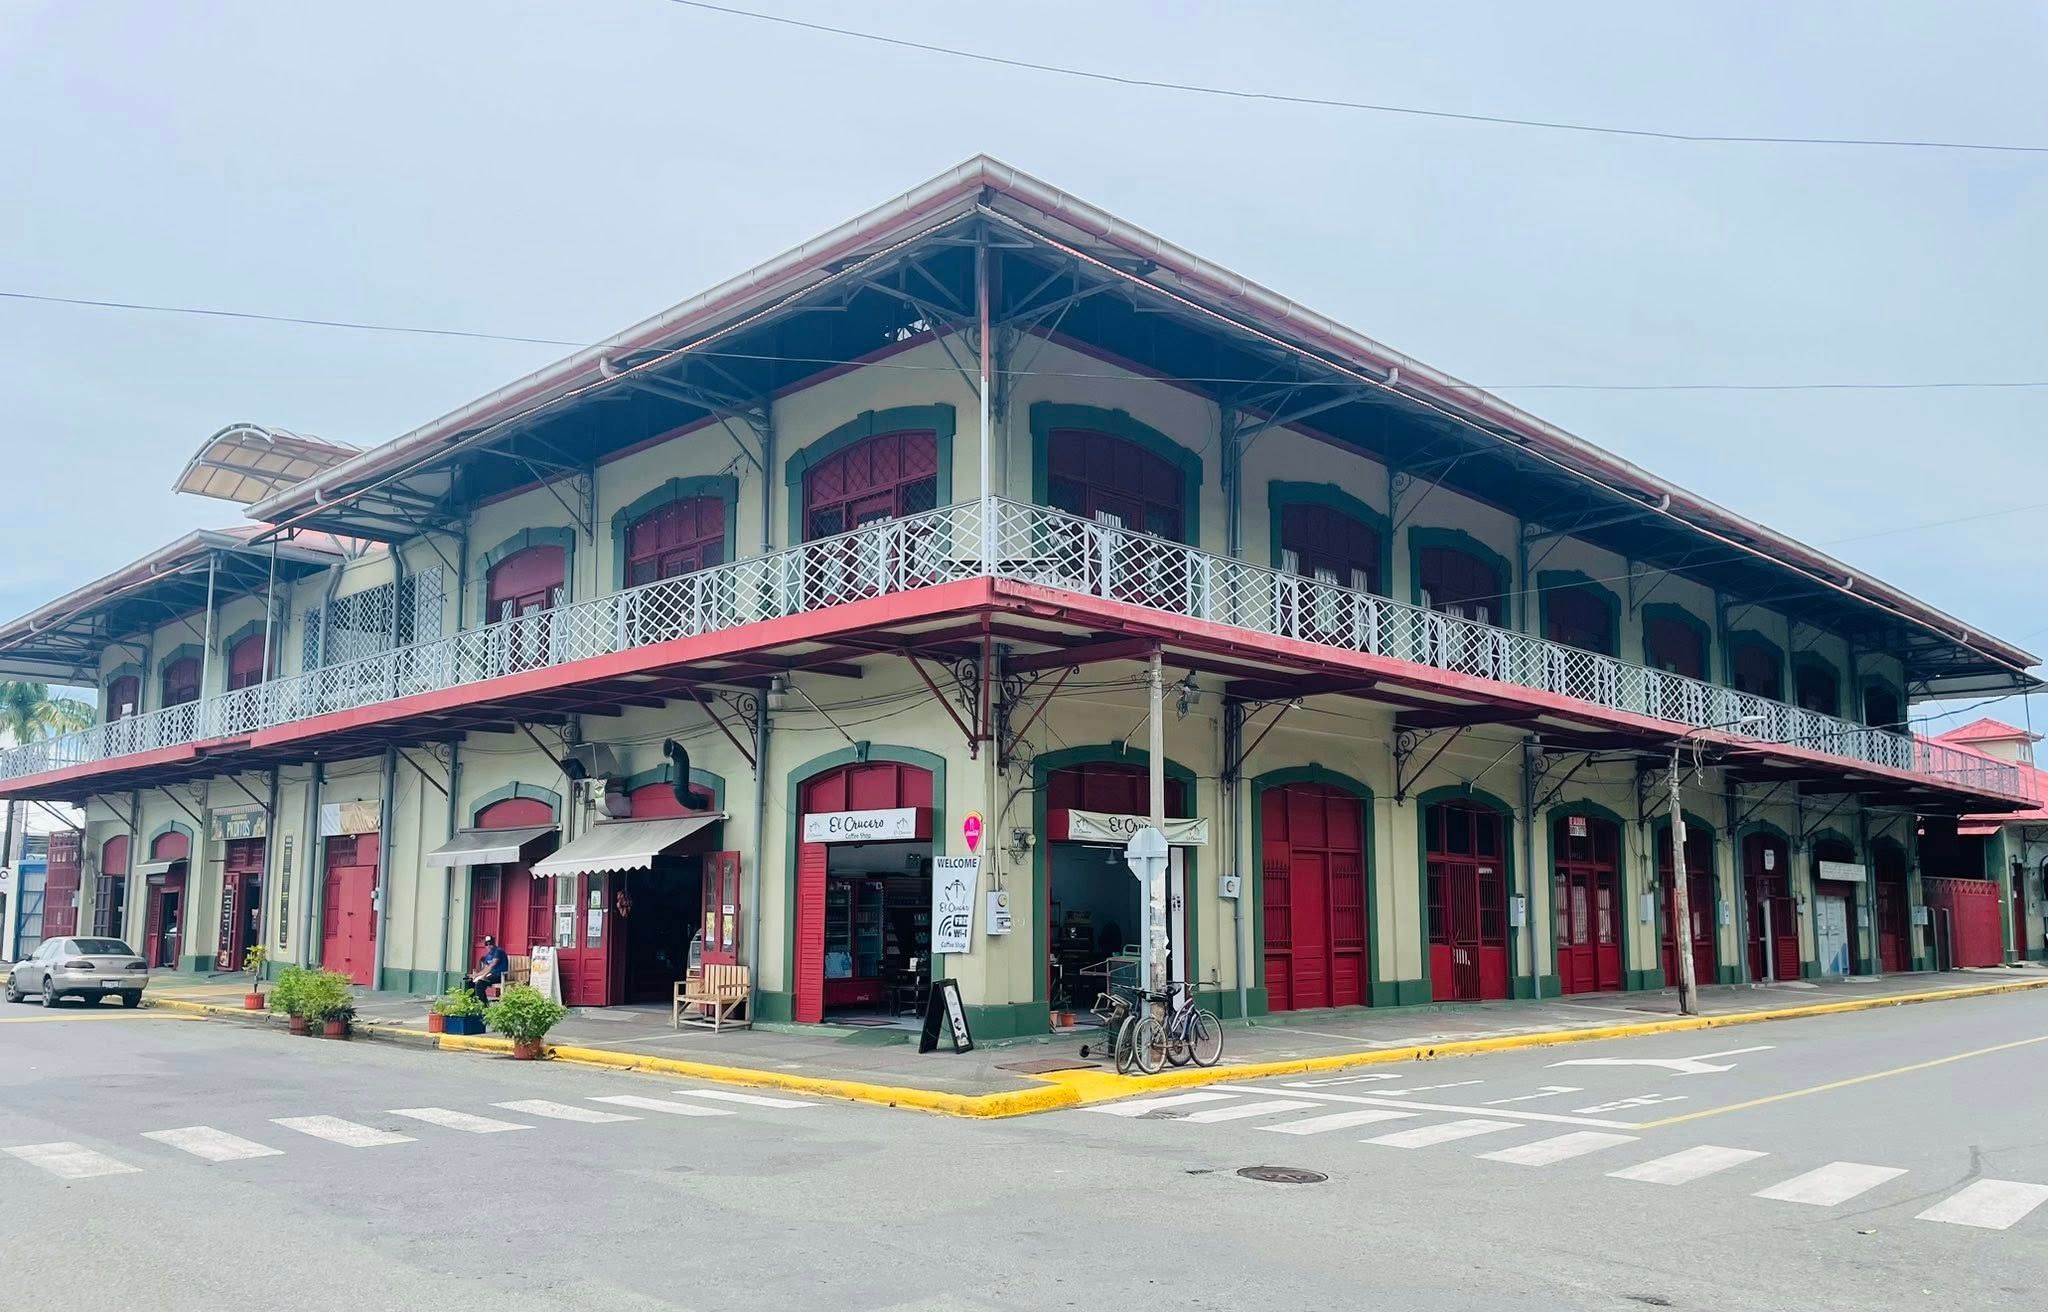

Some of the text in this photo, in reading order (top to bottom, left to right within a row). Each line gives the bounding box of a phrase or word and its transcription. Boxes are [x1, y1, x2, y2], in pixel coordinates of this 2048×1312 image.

[829, 816, 884, 833] El Crucero
[1108, 816, 1123, 833] El
[860, 832, 872, 840] Shop
[937, 858, 977, 868] WELCOME
